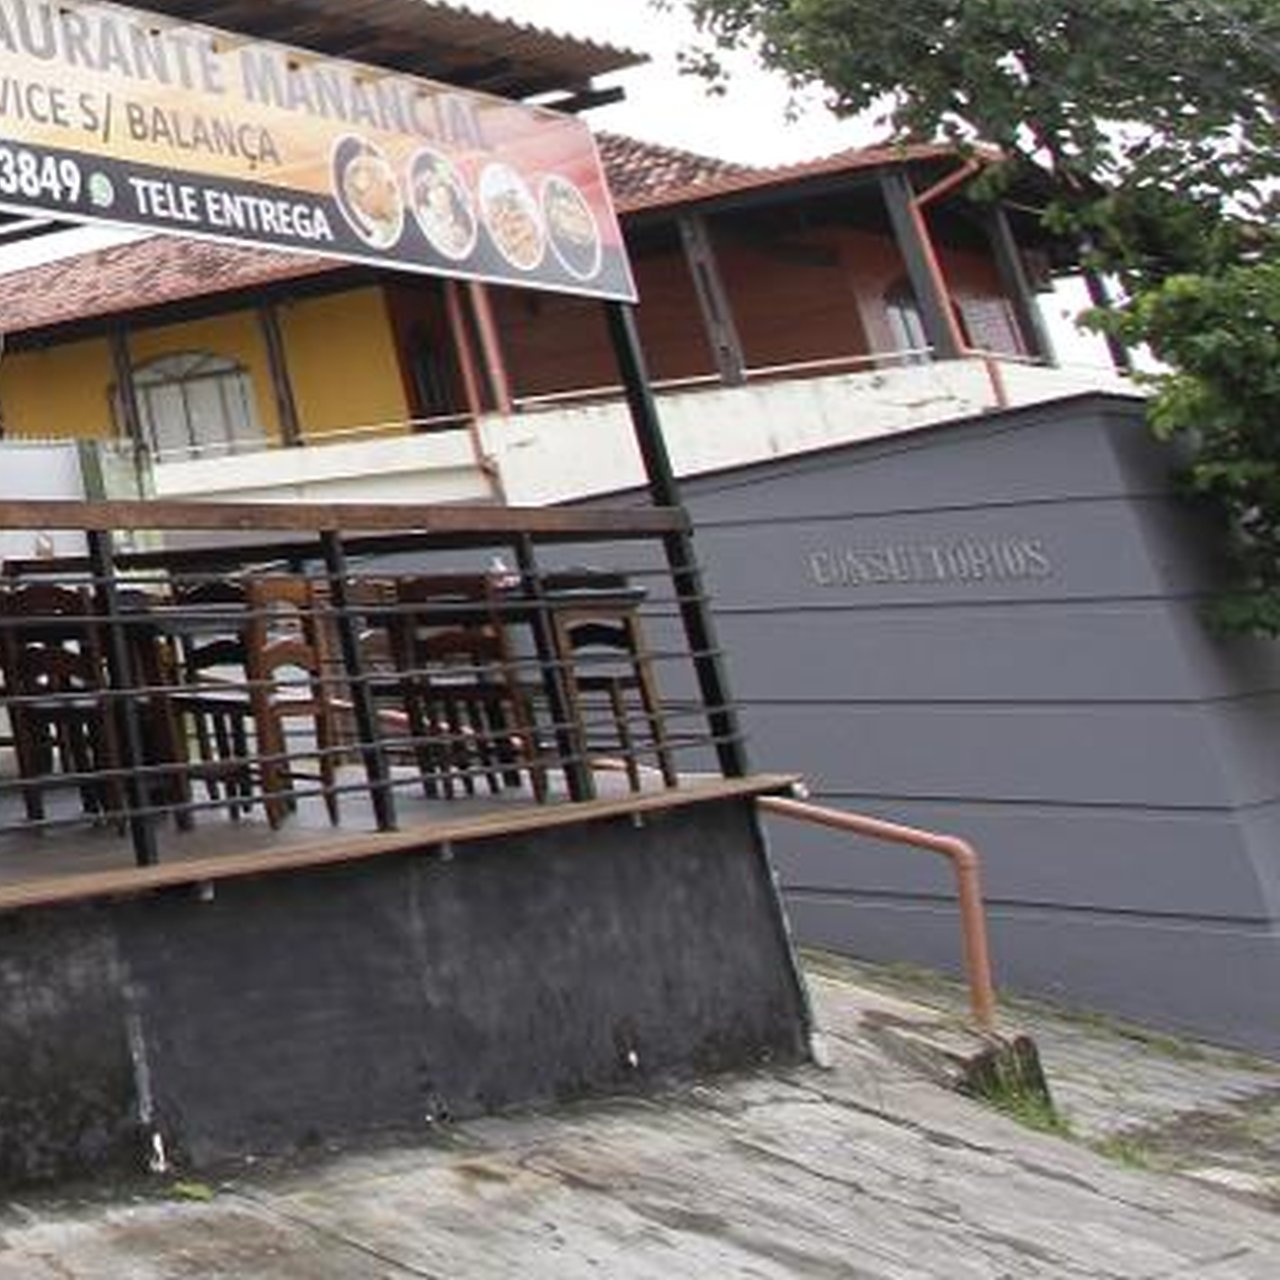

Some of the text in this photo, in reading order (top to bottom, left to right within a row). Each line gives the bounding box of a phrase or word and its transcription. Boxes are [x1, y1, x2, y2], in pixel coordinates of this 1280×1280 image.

[239, 50, 493, 151] MANANCIAL
[126, 102, 282, 170] BALANÇA
[128, 176, 334, 242] TELE ENTREGA
